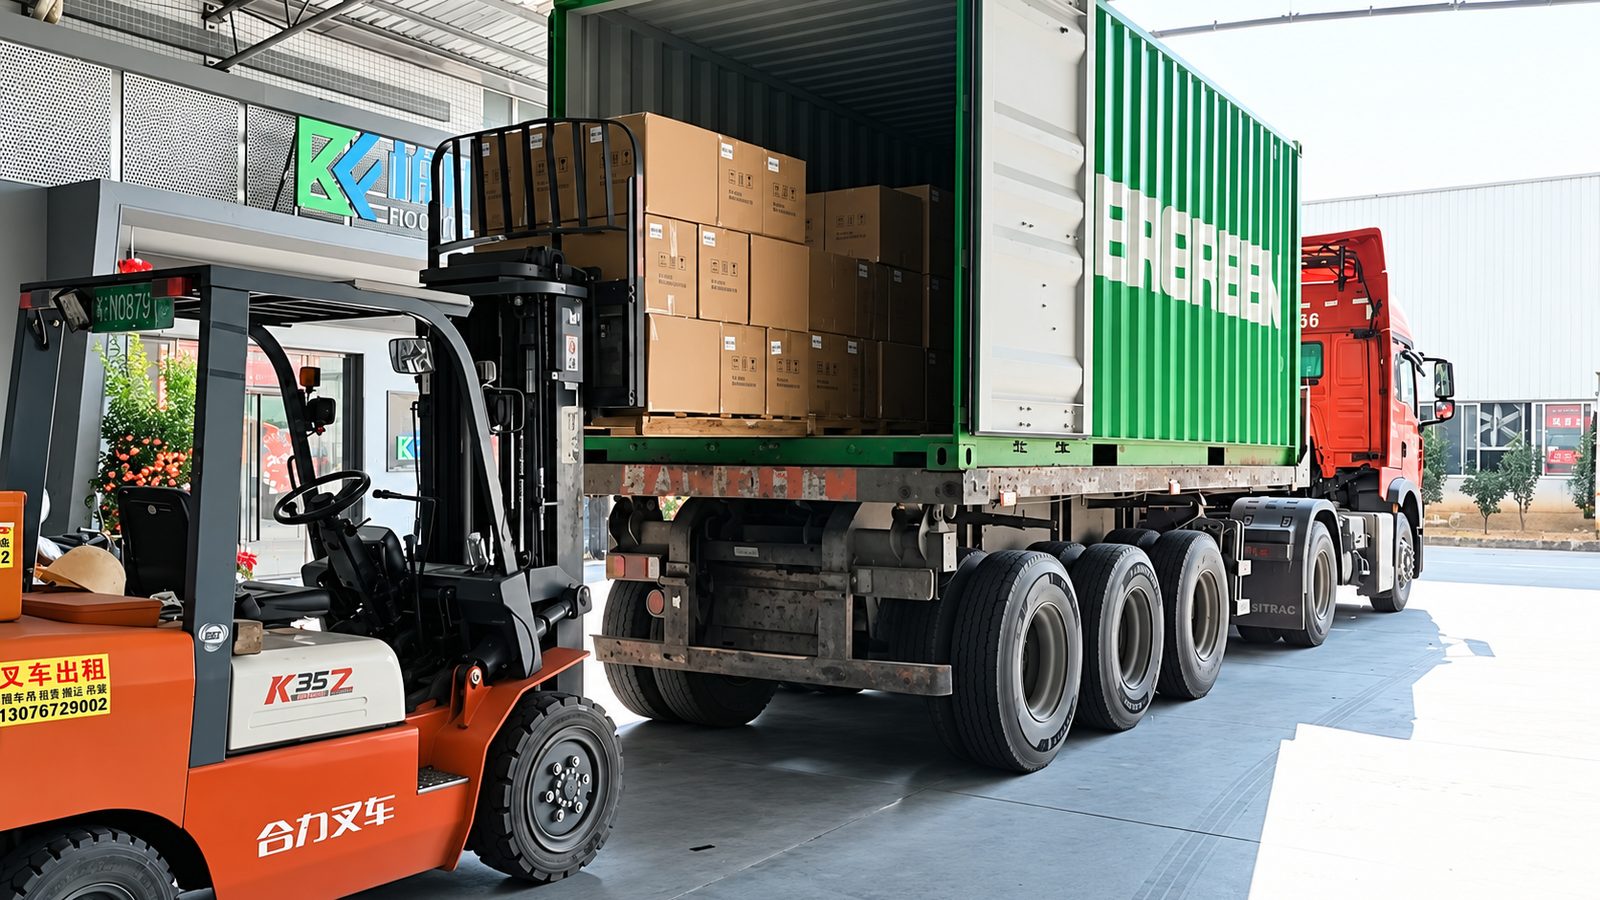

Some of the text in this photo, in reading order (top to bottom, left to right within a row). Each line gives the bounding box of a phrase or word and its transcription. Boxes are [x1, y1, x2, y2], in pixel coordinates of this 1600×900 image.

[1251, 603, 1296, 615] SITRAC
[0, 658, 106, 689] 叉车出租
[0, 697, 107, 722] 13076729002
[256, 794, 396, 858] 合力叉车
